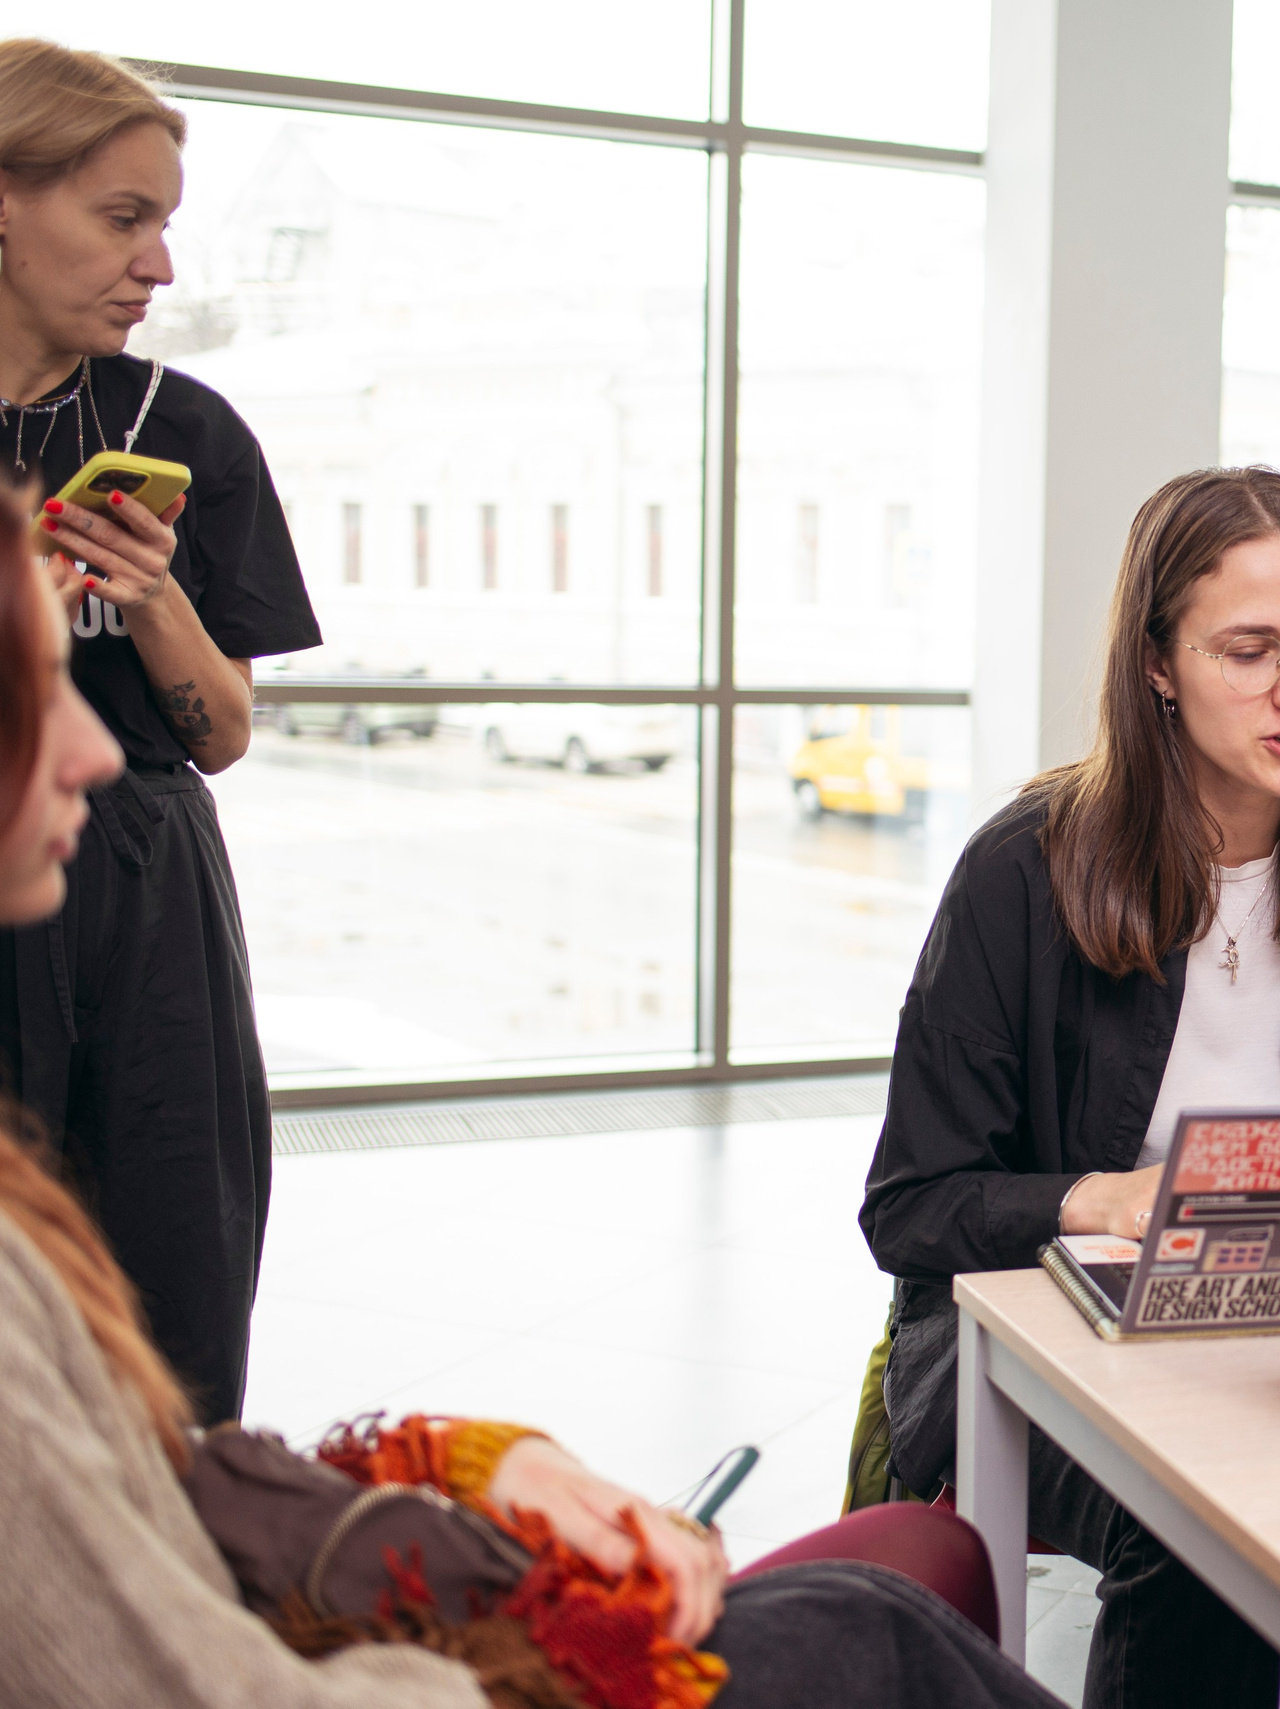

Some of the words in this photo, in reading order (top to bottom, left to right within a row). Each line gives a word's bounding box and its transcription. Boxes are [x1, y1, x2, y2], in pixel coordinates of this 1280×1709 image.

[1150, 1279, 1193, 1300] HSE
[1193, 1277, 1239, 1298] ART
[1142, 1298, 1224, 1322] DESIGN
